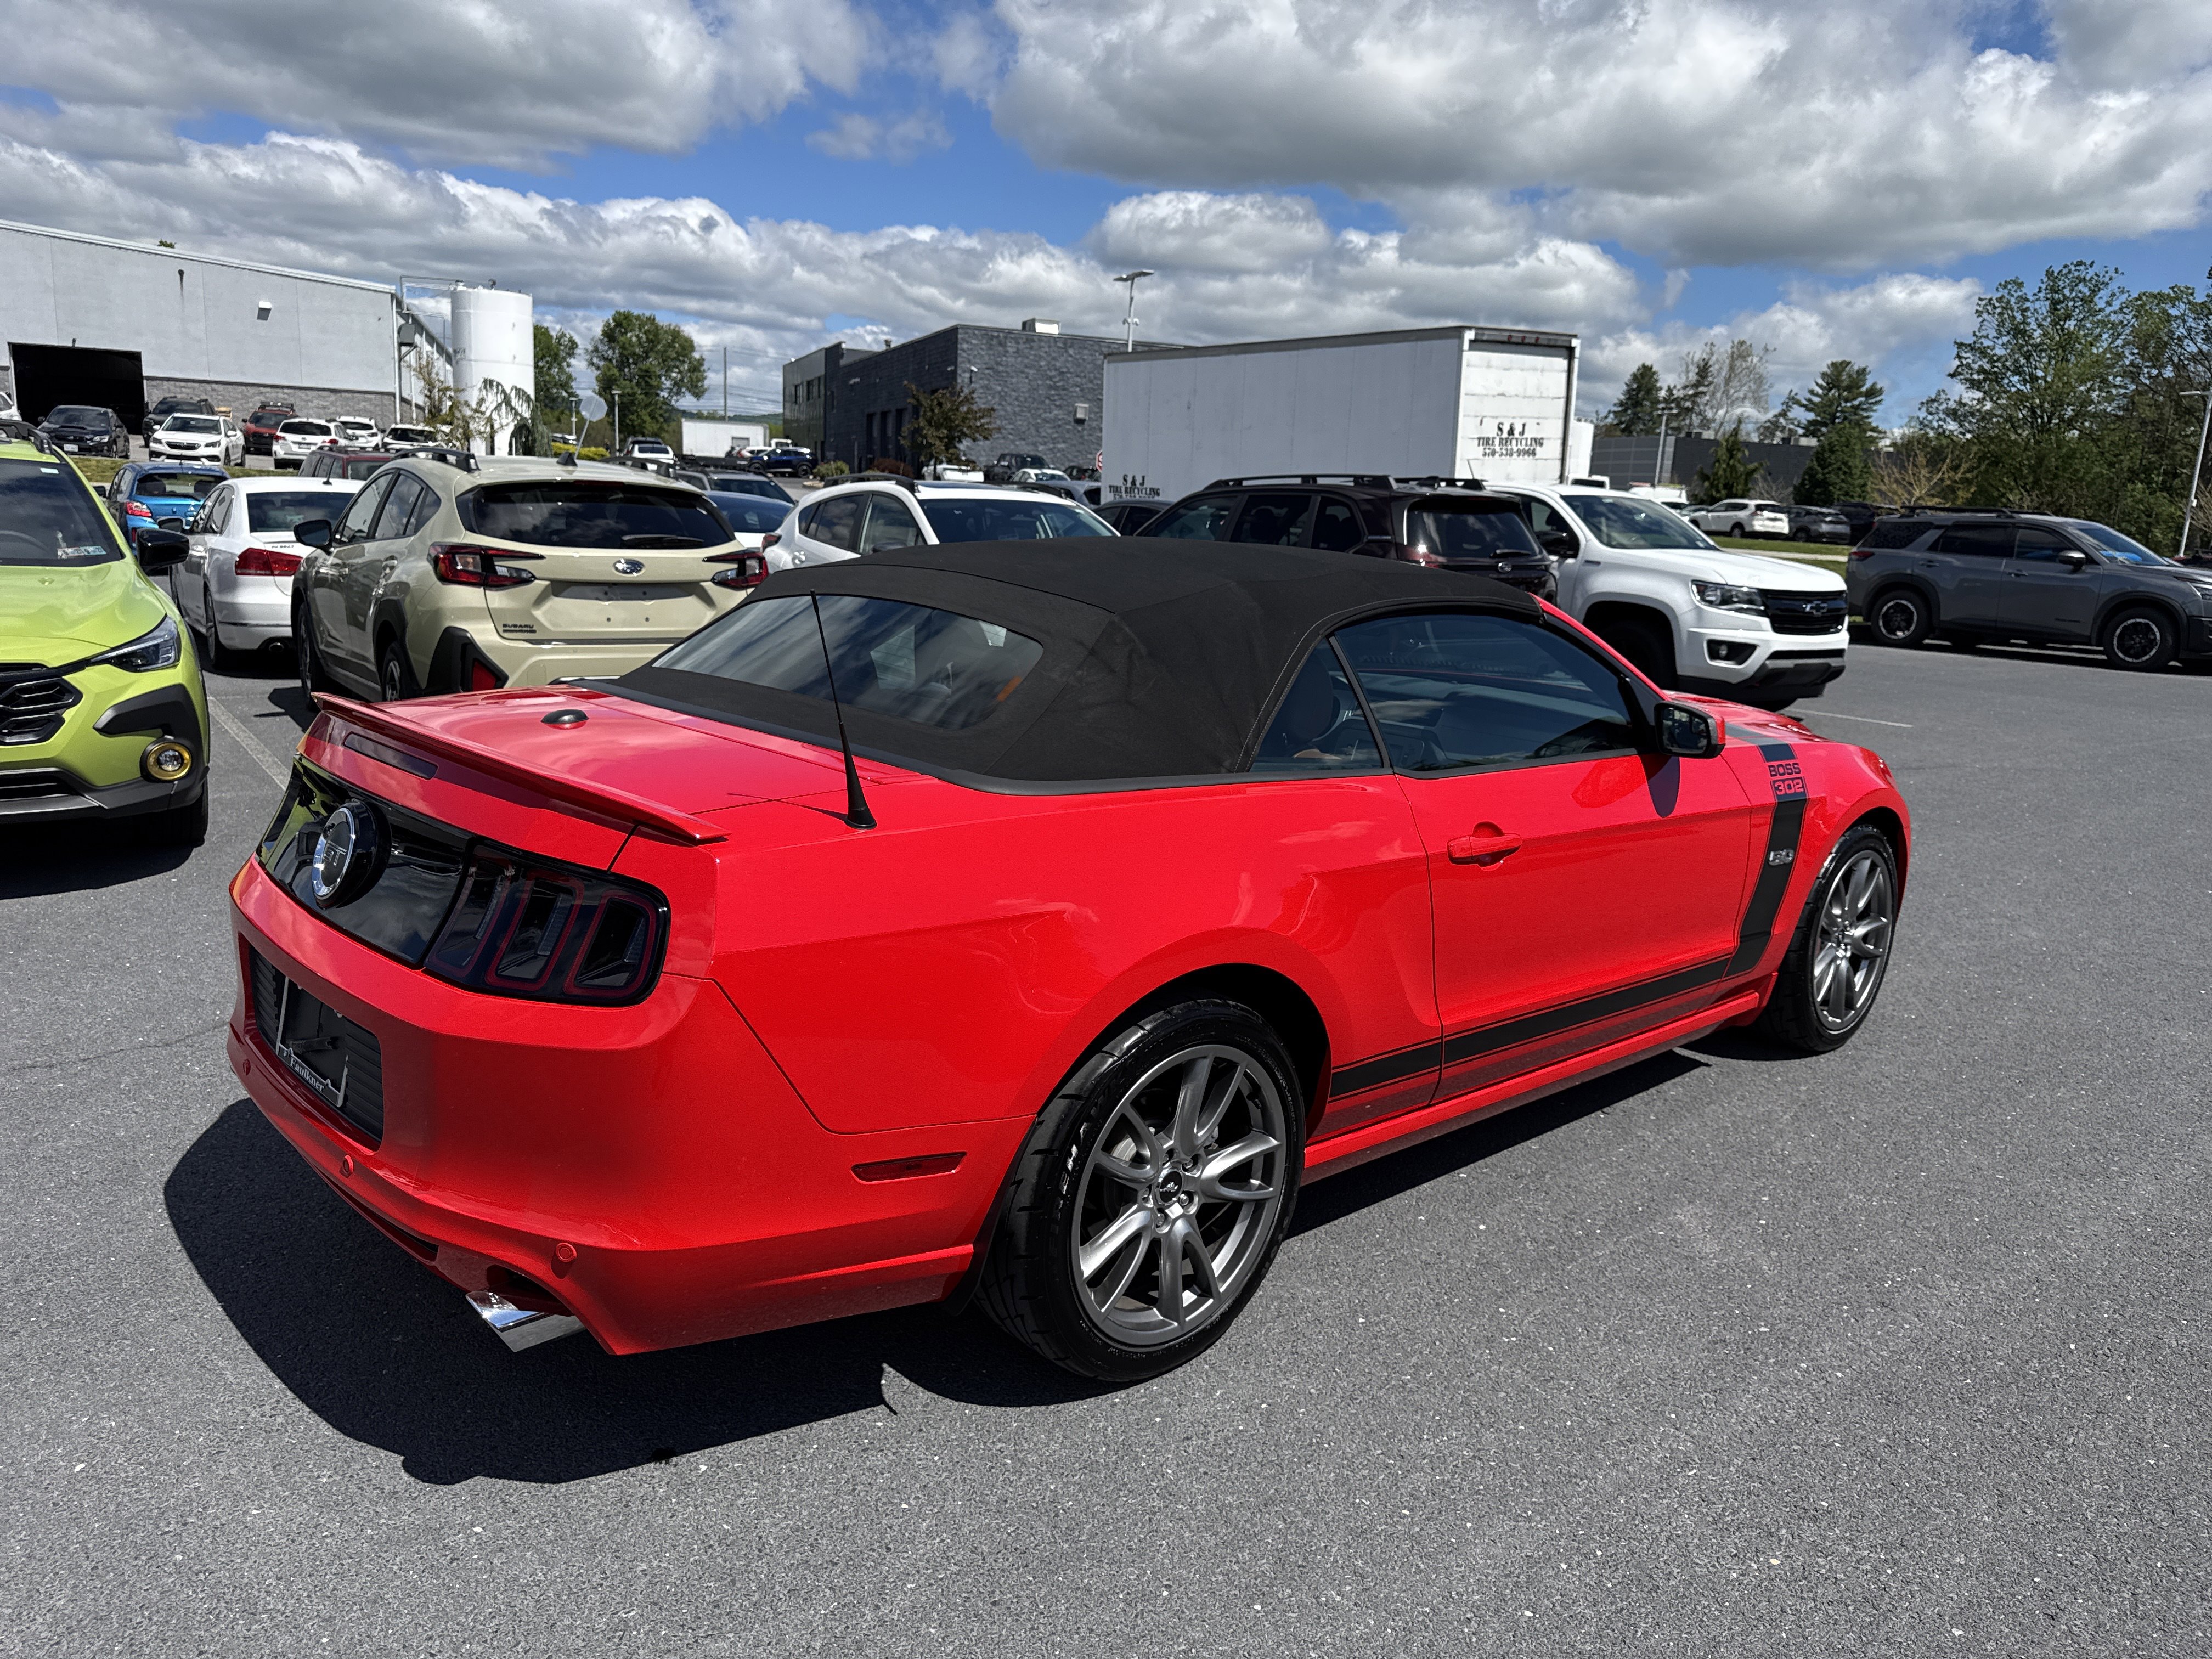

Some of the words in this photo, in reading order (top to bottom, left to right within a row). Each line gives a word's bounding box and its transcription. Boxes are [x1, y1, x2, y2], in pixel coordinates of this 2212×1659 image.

[1496, 422, 1504, 436] S
[1507, 422, 1515, 437] &
[1519, 422, 1526, 437] J
[1477, 437, 1496, 447] TIRE
[1498, 437, 1544, 448] RECYCLING
[1482, 447, 1536, 457] 570-538-9966
[1122, 474, 1128, 486] S
[1131, 475, 1137, 487] &
[1139, 475, 1146, 487] J
[1109, 485, 1122, 494] TIRE
[1124, 486, 1160, 496] RECYCLING
[1768, 763, 1801, 777] BOSS
[1775, 779, 1804, 795] 302
[290, 1058, 324, 1092] Faulkner
